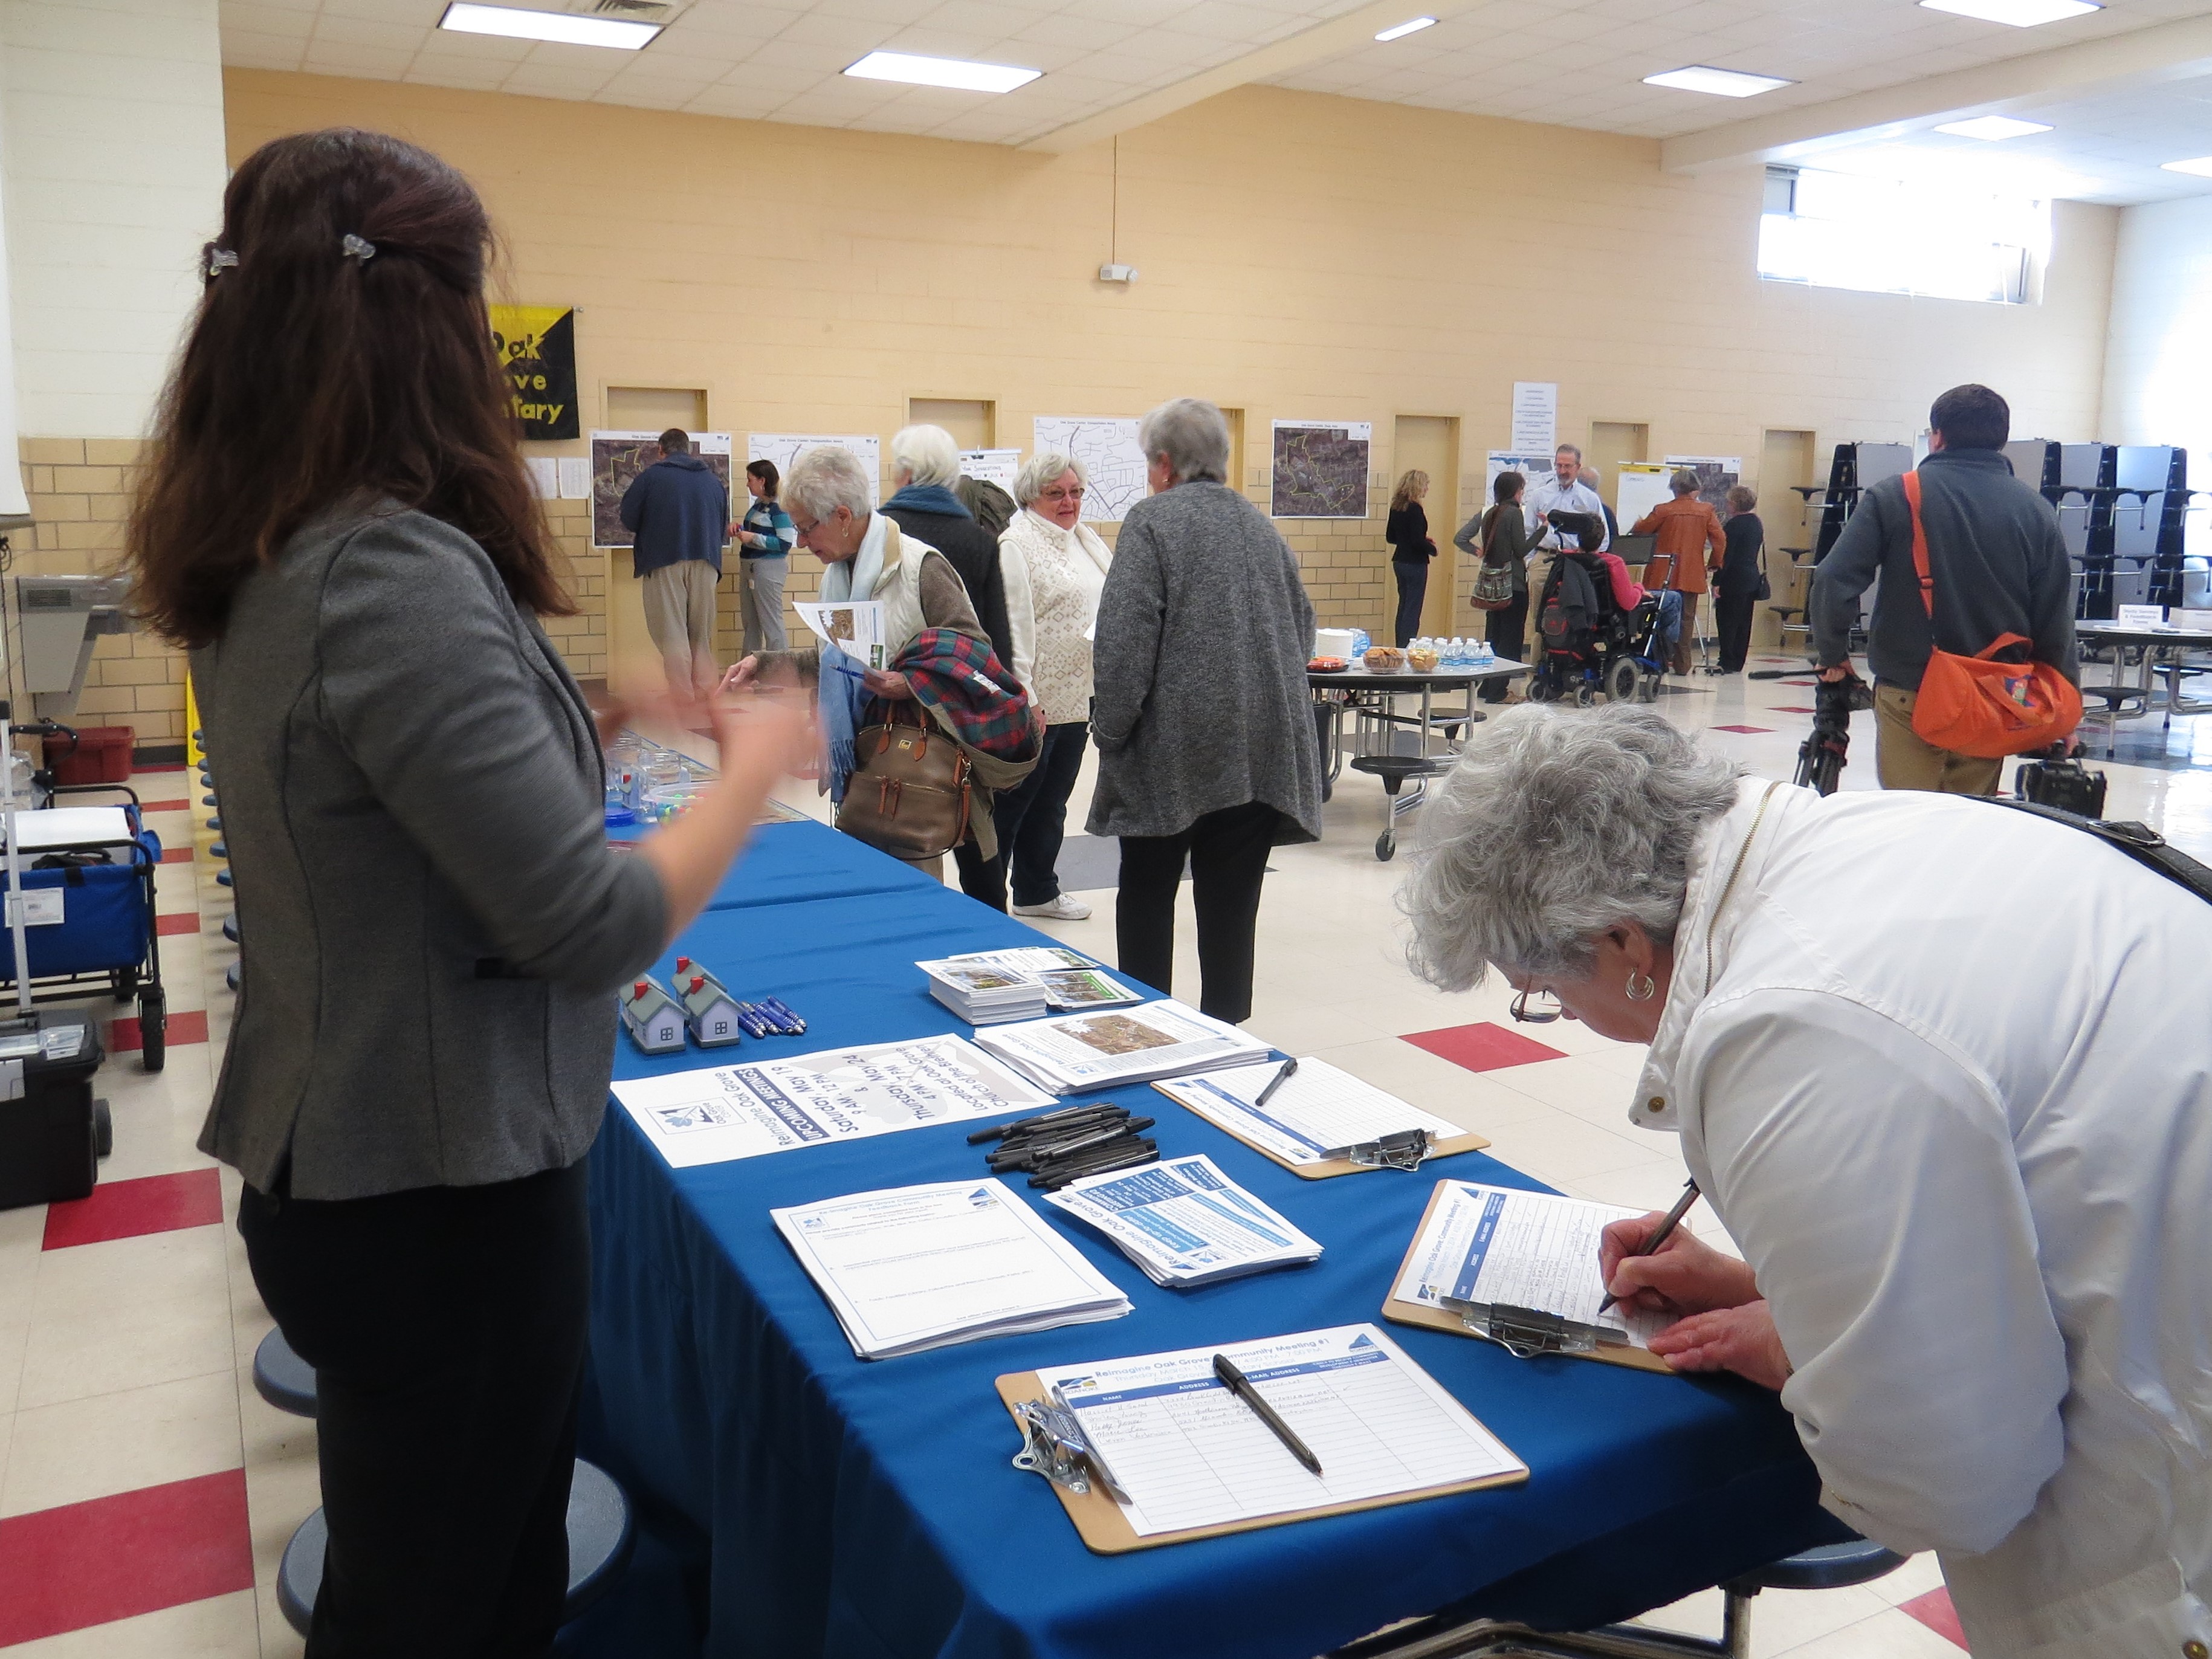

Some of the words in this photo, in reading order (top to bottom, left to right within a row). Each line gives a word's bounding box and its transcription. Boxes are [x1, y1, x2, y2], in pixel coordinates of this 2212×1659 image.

[840, 1054, 867, 1064] 24
[891, 1047, 925, 1064] Grove
[912, 1044, 954, 1067] Brethren
[769, 1065, 794, 1075] 19
[853, 1063, 891, 1081] May
[882, 1064, 905, 1075] PM
[914, 1064, 944, 1078] Oak
[944, 1067, 969, 1078] the
[710, 1072, 742, 1092] Grove
[736, 1069, 782, 1099] MEETINGS
[780, 1074, 818, 1093] May
[808, 1073, 831, 1084] PM
[957, 1076, 979, 1084] of
[820, 1083, 841, 1091] 12
[908, 1084, 932, 1095] PM
[730, 1092, 757, 1107] Oak
[835, 1096, 861, 1109] AM
[875, 1081, 940, 1120] Thursday,
[943, 1084, 990, 1111] Located
[969, 1084, 1011, 1107] Church
[768, 1098, 825, 1139] UPCOMING
[801, 1092, 864, 1133] Saturday,
[746, 1107, 799, 1145] Reimagine
[1078, 1190, 1119, 1211] COMMUNITY
[1072, 1200, 1105, 1218] Grove
[1099, 1217, 1127, 1231] Oak
[1123, 1231, 1181, 1264] Reimagine
[1159, 1236, 1182, 1248] Keep
[1427, 1252, 1438, 1261] Oak
[1094, 1364, 1153, 1378] Reimagine
[1151, 1360, 1177, 1369] Oak
[1273, 1340, 1319, 1353] Meeting
[1113, 1371, 1158, 1382] Thursday
[1158, 1366, 1192, 1375] March
[1176, 1371, 1206, 1379] Grove
[1261, 1357, 1297, 1366] School
[1268, 1367, 1301, 1376] ADDRESS
[1177, 1381, 1211, 1390] ADDRESS
